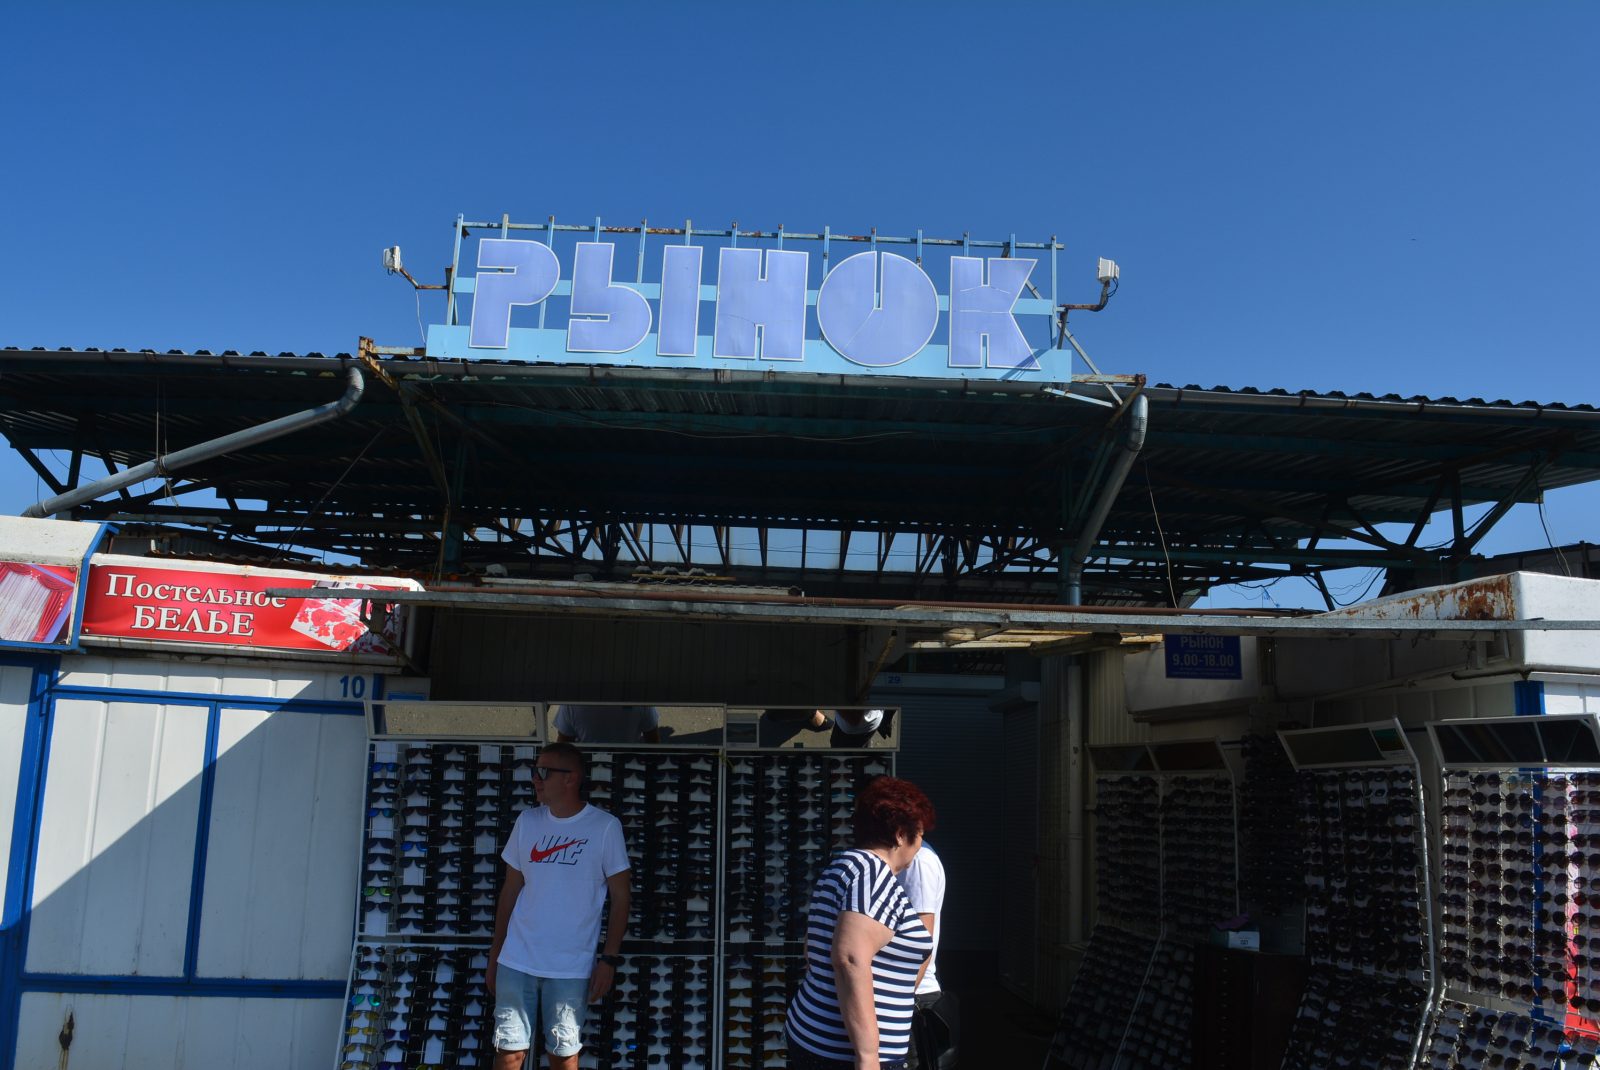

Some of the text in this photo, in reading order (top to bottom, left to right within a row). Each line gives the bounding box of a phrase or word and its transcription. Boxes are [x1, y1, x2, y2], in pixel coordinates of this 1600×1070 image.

[469, 238, 1041, 370] РЫНОК
[105, 573, 287, 609] Постельное
[131, 604, 255, 637] БЕЛЬЕ
[1180, 635, 1225, 649] РЫНОК
[1172, 653, 1235, 667] 9.00-18.00
[339, 675, 366, 699] 10
[887, 675, 901, 685] 29
